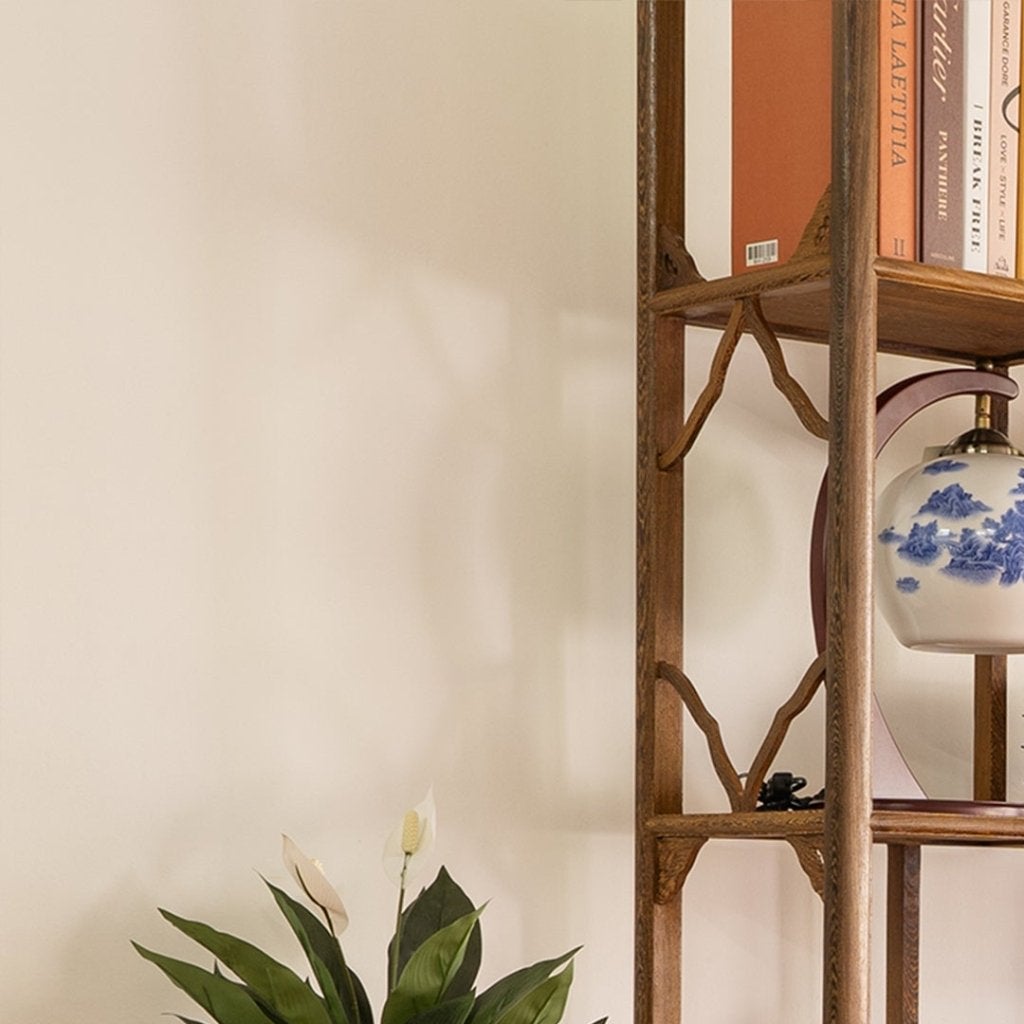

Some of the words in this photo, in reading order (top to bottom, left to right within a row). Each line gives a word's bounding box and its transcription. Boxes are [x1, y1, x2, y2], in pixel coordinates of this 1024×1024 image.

[932, 0, 959, 103] artier
[1002, 1, 1010, 55] GARANCE
[891, 38, 907, 168] LAETITIA
[937, 130, 949, 222] PANTHERE
[971, 119, 983, 190] BREAK
[999, 134, 1007, 164] LOVE
[998, 175, 1006, 207] STYLE
[970, 198, 983, 254] FREE
[998, 219, 1006, 241] LIFE
